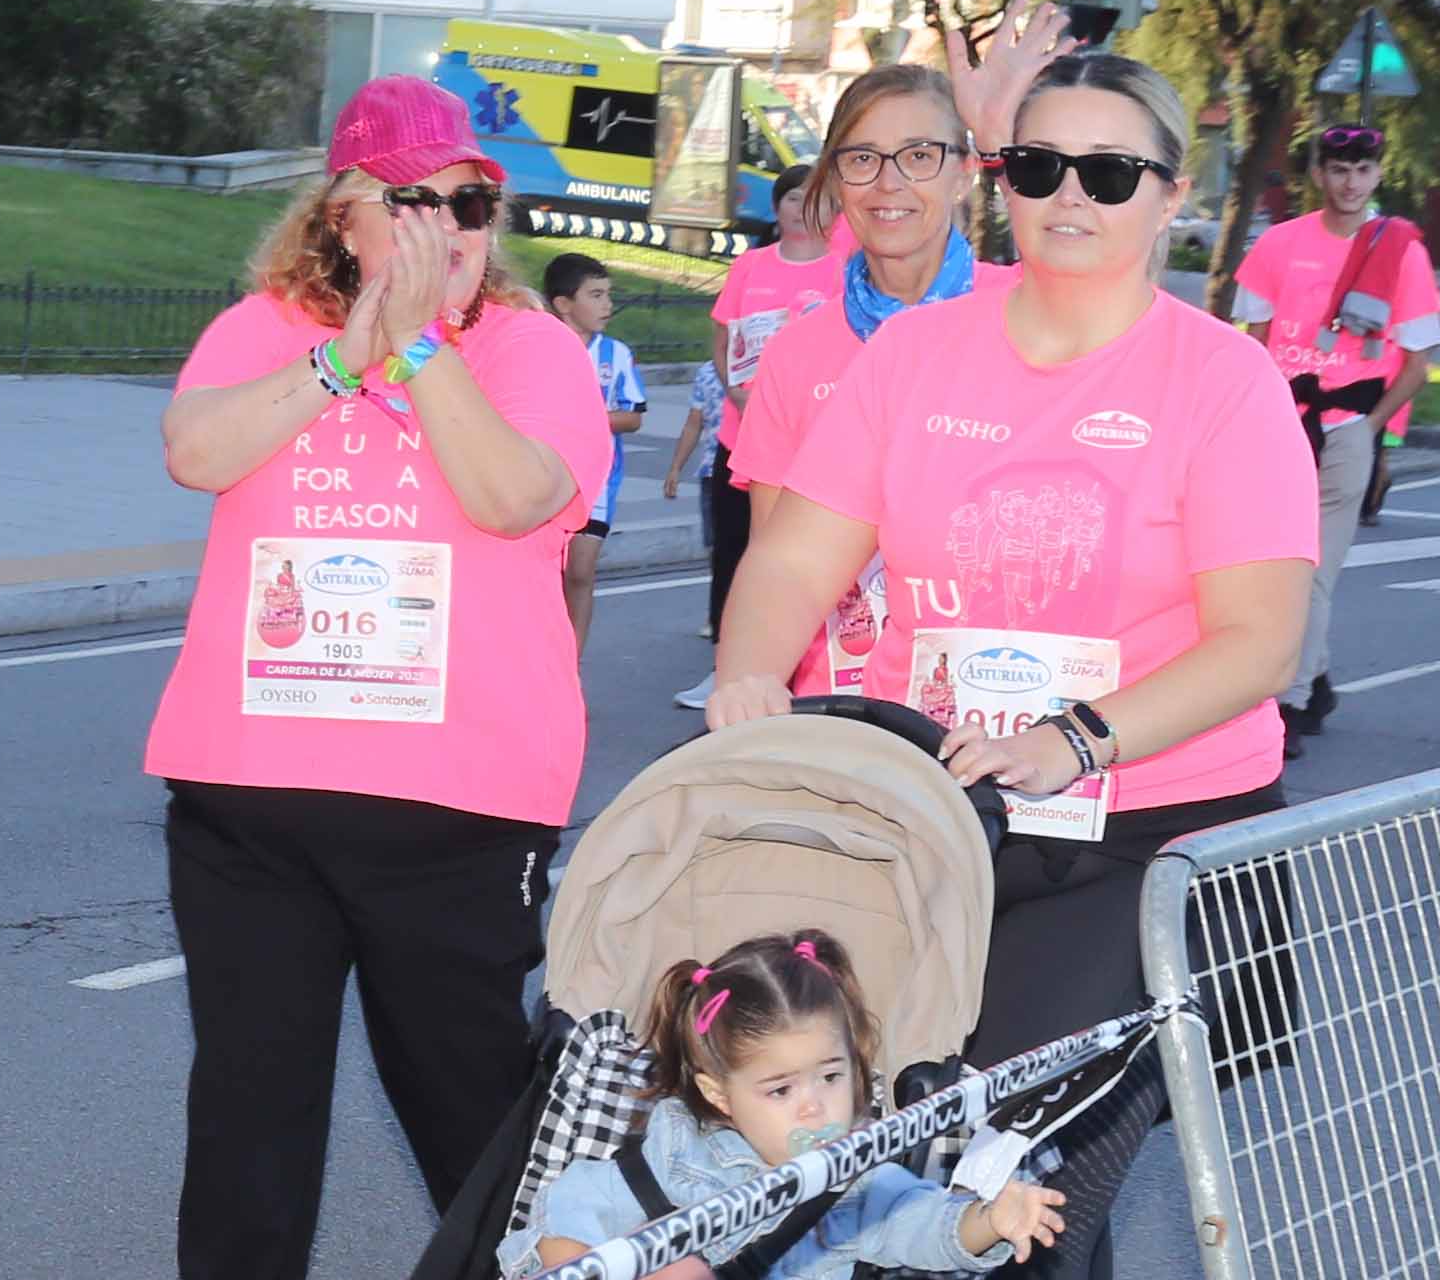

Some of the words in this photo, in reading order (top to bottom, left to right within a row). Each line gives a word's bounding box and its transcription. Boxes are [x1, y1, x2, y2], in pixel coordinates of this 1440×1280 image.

[927, 415, 1012, 443] OYSHO
[293, 467, 352, 492] FOR
[397, 465, 420, 489] A
[295, 503, 417, 529] REASON
[311, 570, 382, 586] ASTURIANA
[905, 576, 961, 620] TU
[311, 610, 377, 635] 016
[323, 643, 363, 659] 1903
[266, 664, 318, 675] CARRERA
[320, 666, 337, 677] DE
[339, 667, 352, 677] LA
[964, 665, 1043, 684] ASTURIANA
[1060, 664, 1105, 679] SUMA
[261, 688, 317, 704] OYSHO
[366, 693, 428, 708] Santander
[963, 708, 1033, 737] 016
[1017, 803, 1087, 823] Santander
